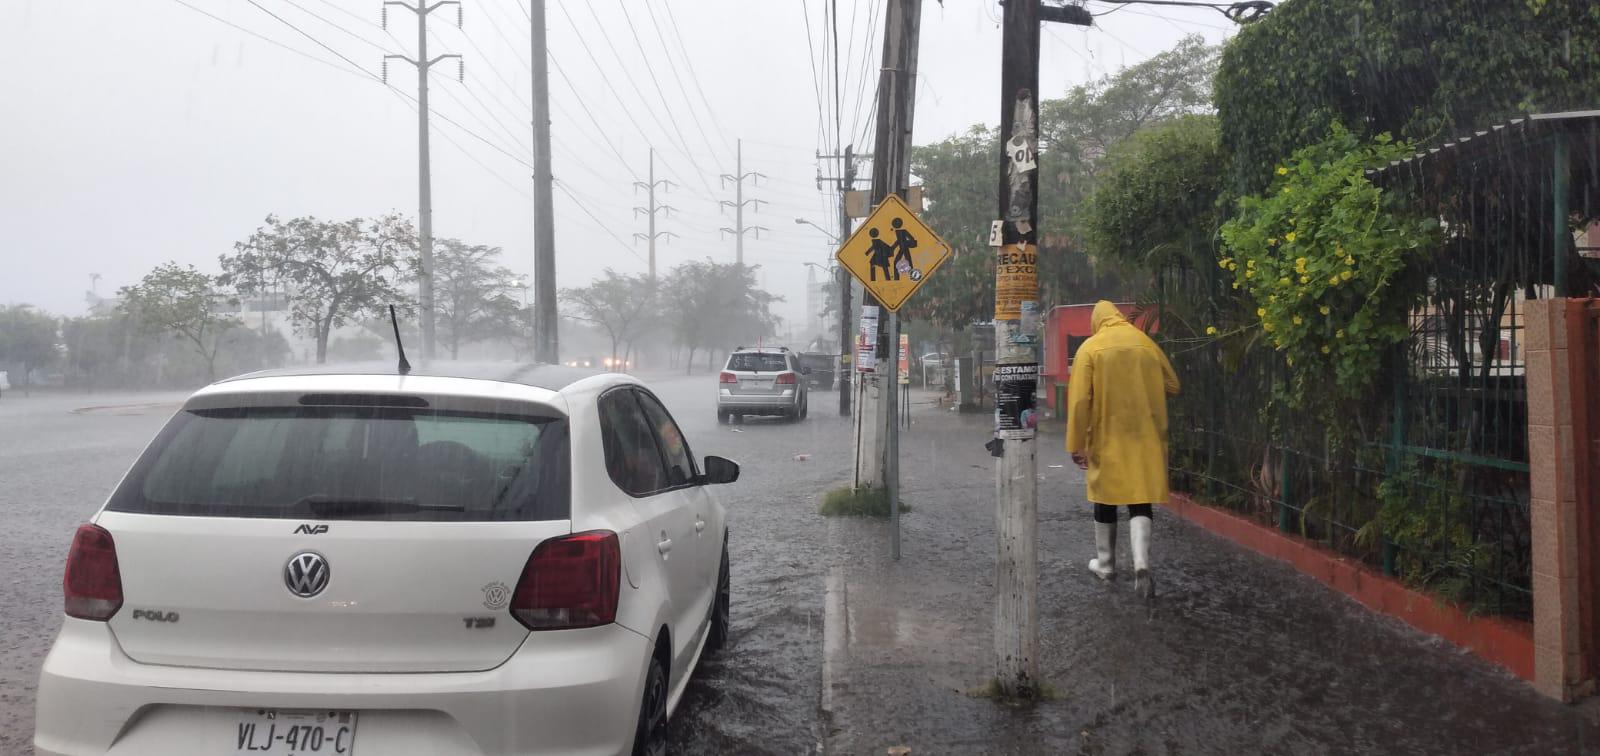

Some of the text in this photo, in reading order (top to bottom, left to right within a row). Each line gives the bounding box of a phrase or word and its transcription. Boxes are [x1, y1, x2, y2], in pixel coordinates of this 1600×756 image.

[293, 524, 329, 534] AVP
[132, 609, 180, 622] POLO
[237, 722, 349, 754] VLJ-470-C
